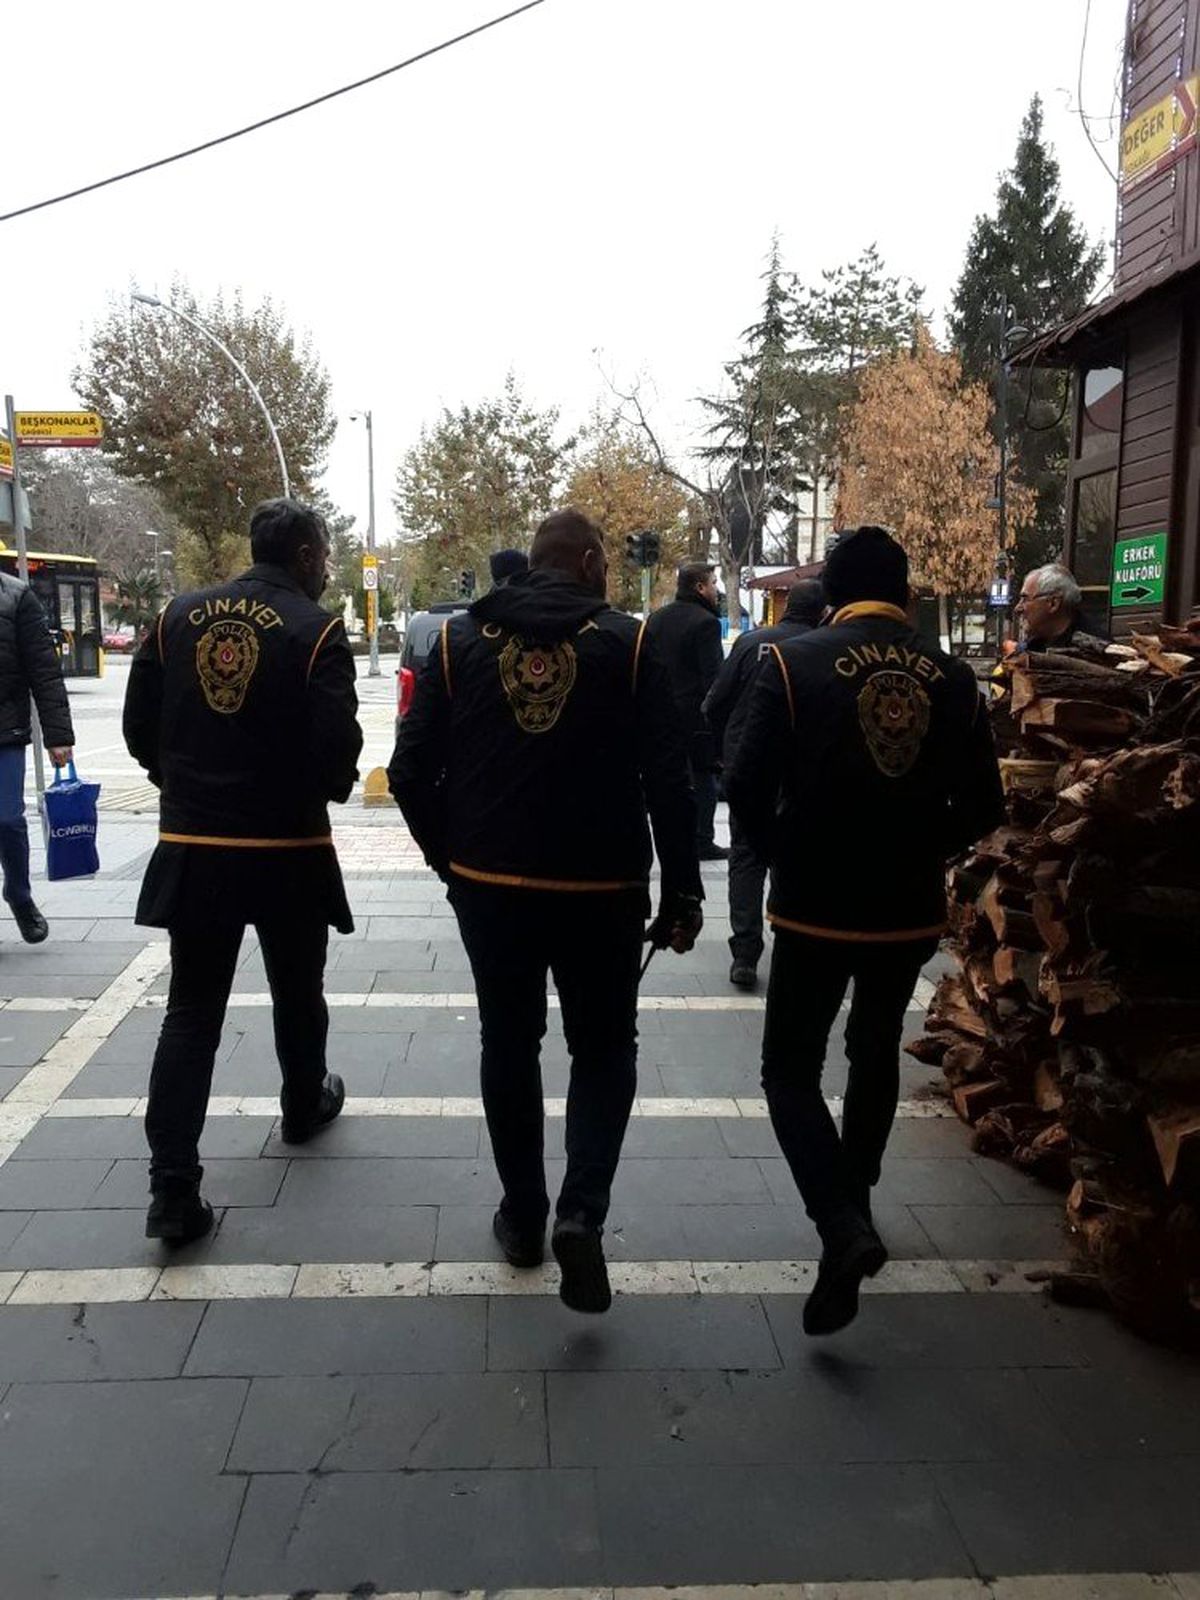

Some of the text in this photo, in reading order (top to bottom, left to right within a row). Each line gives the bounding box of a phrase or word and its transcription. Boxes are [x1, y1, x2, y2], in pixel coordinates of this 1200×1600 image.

[1123, 111, 1165, 156] DEĞER
[20, 416, 97, 427] BEŞKONAKLAR
[1123, 545, 1156, 563] ERKEK
